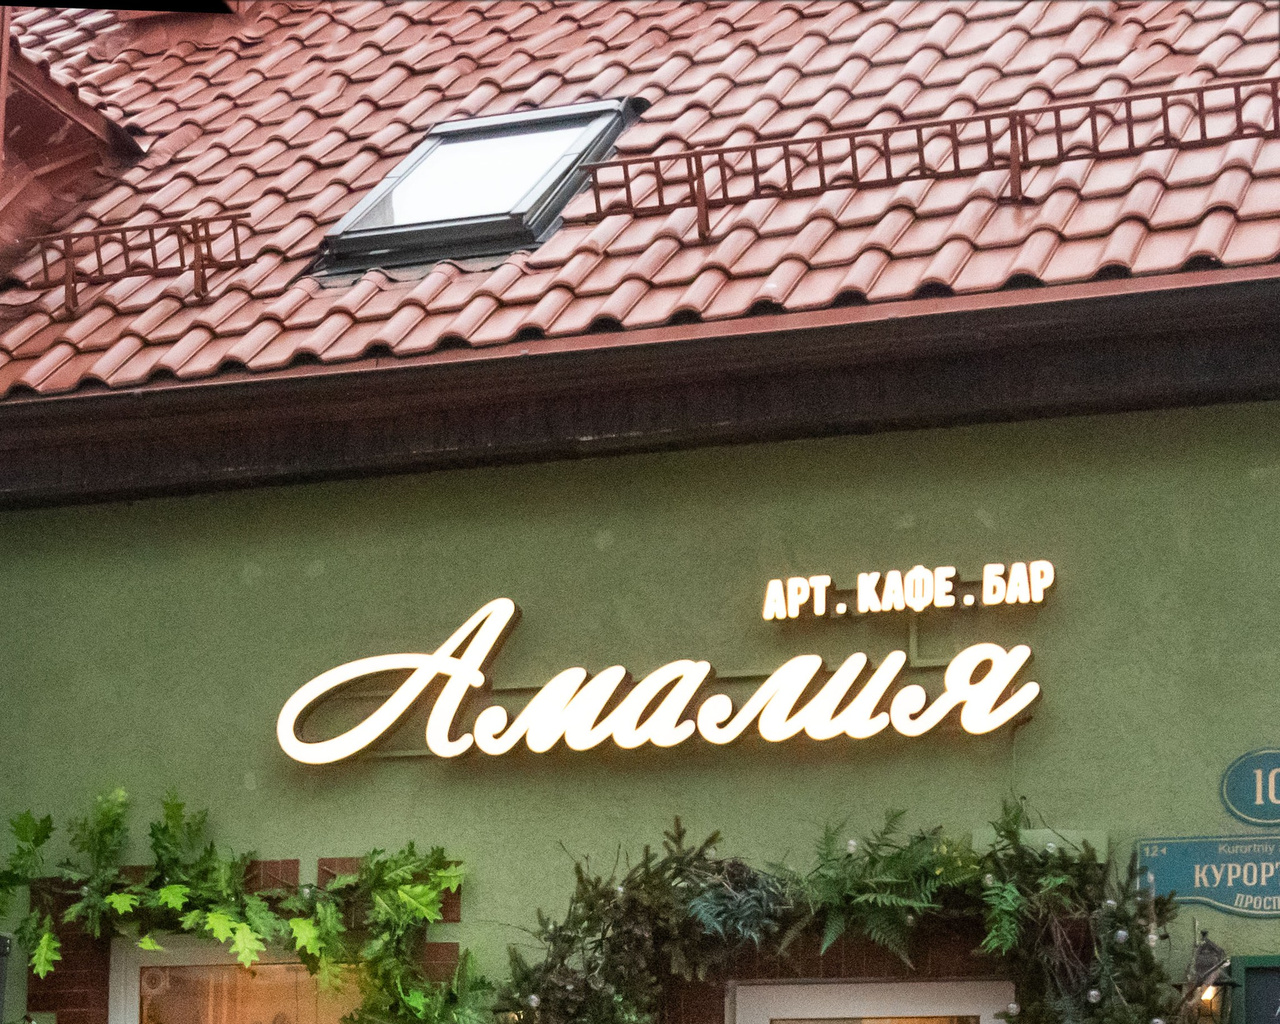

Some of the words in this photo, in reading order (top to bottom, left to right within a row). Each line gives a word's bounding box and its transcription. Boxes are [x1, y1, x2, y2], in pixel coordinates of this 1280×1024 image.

[983, 559, 1055, 607] БАР
[276, 597, 1041, 765] Амалия
[1219, 844, 1275, 855] Kurortniy
